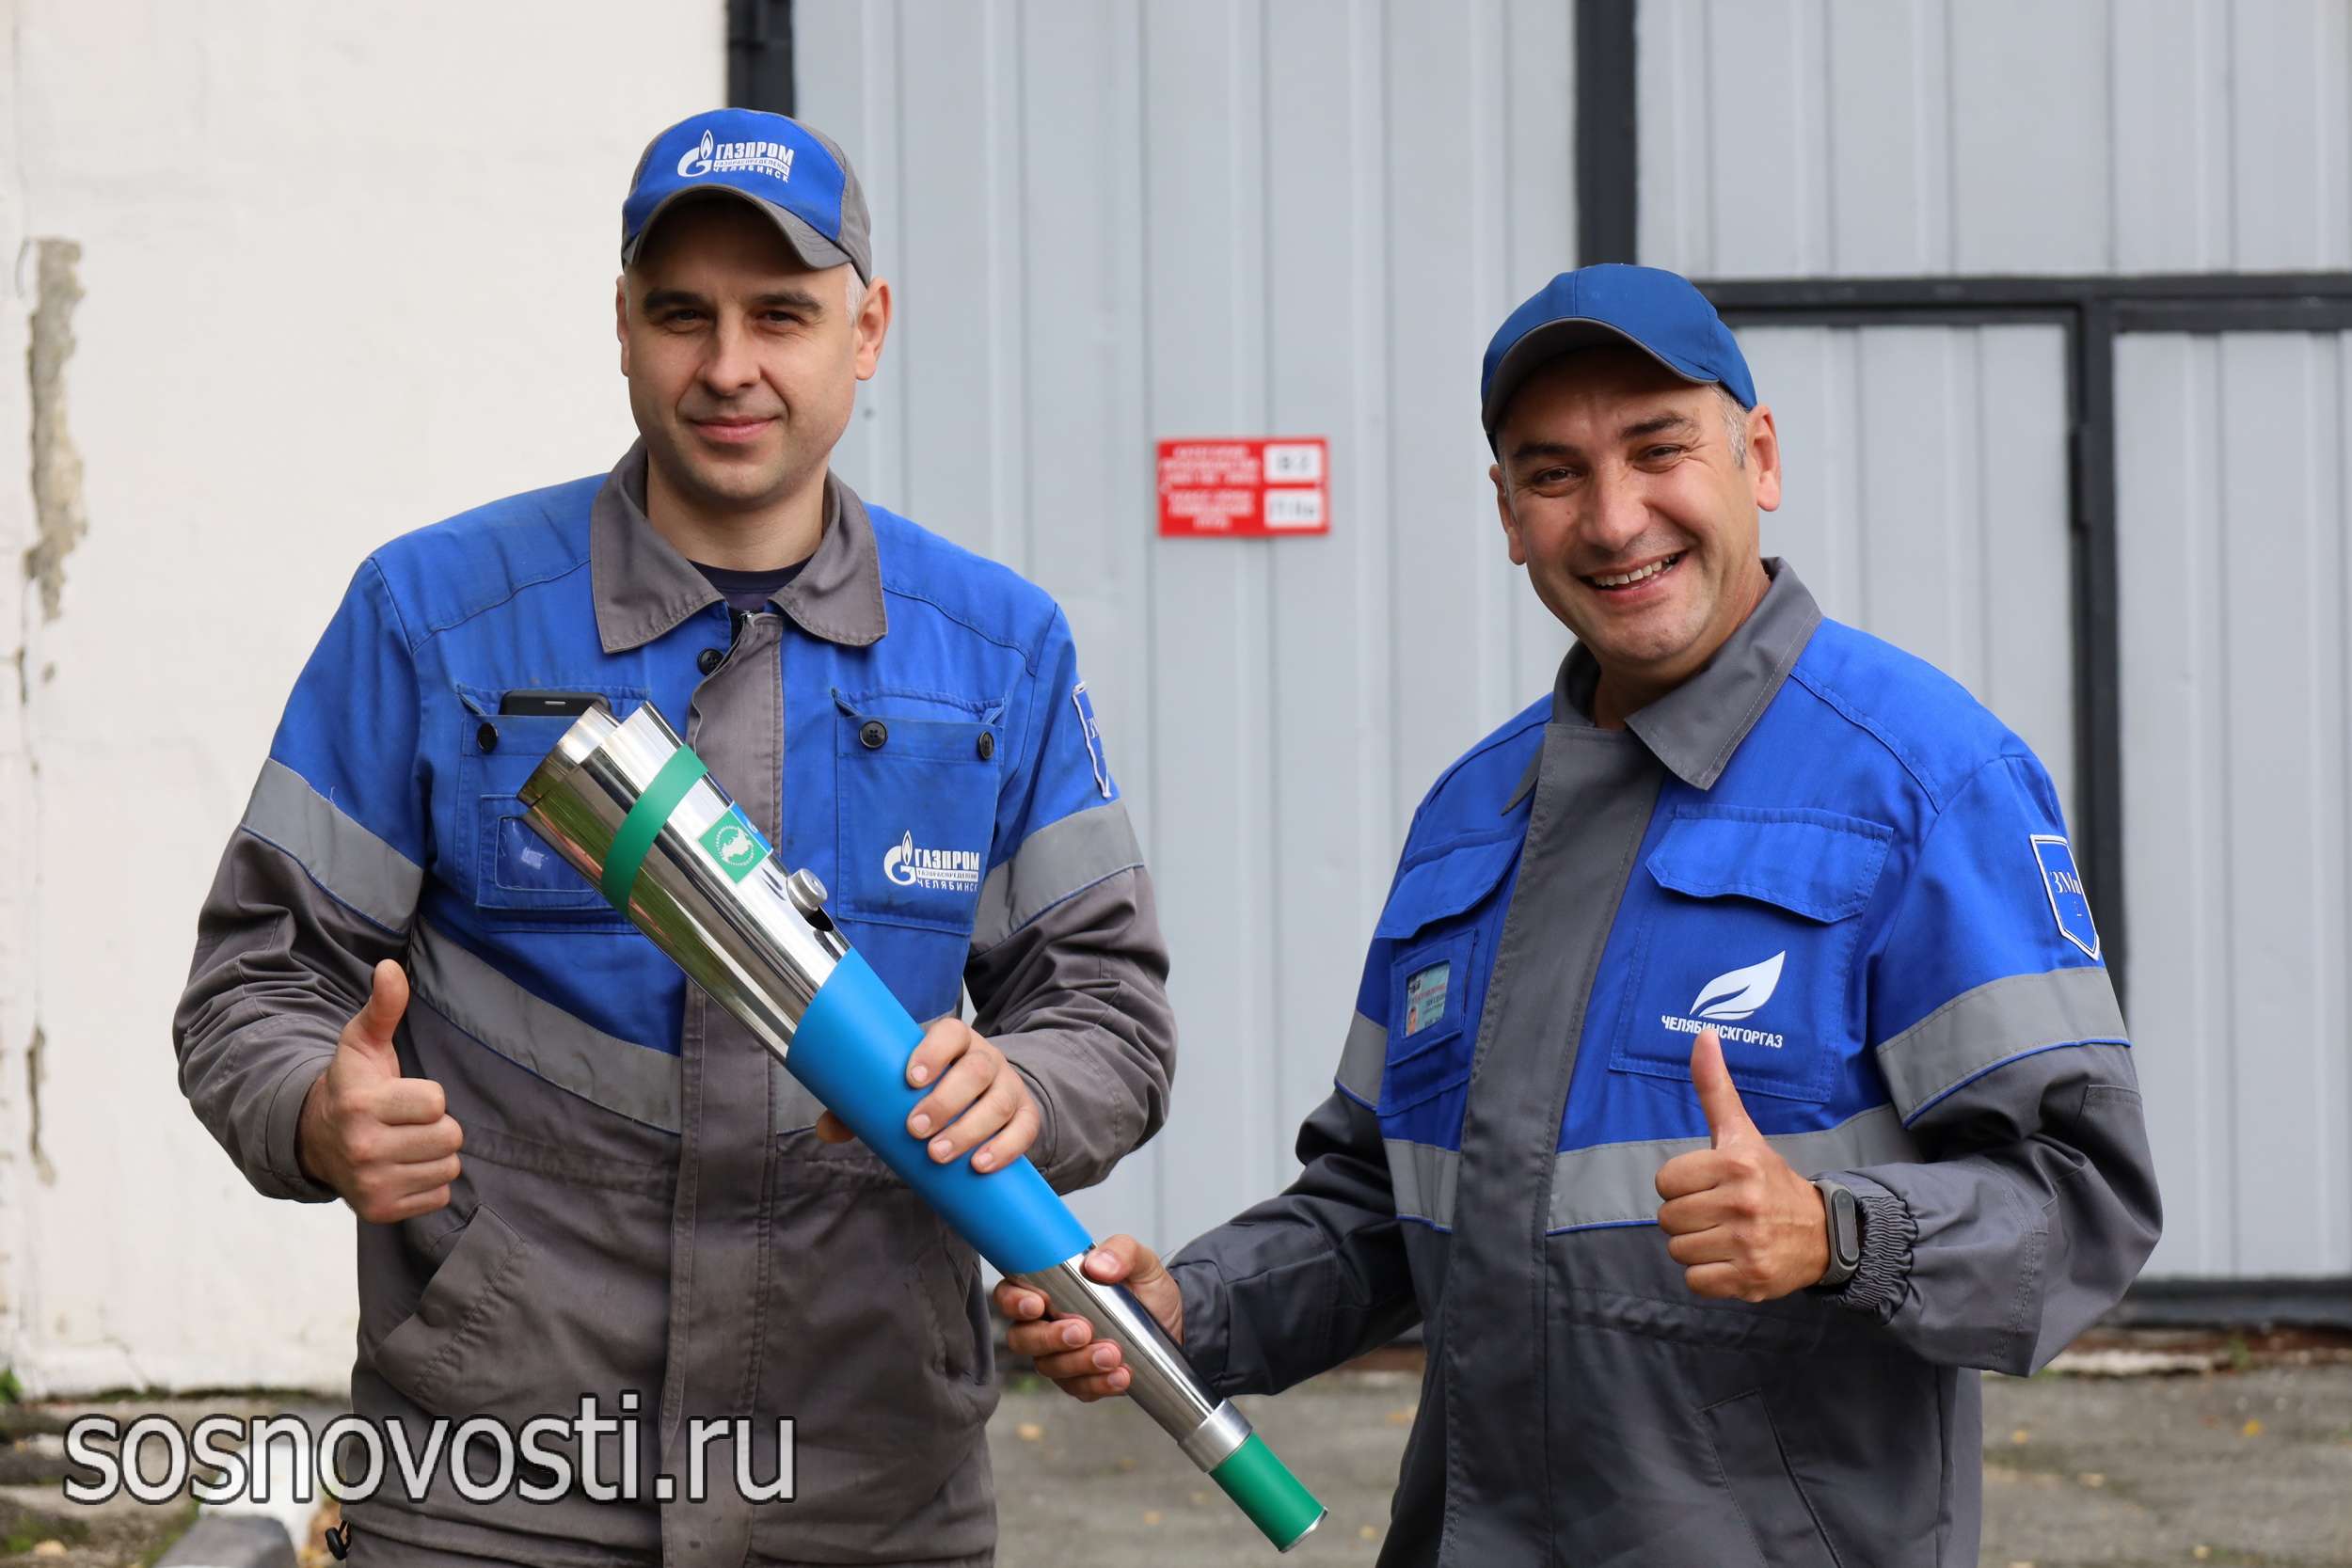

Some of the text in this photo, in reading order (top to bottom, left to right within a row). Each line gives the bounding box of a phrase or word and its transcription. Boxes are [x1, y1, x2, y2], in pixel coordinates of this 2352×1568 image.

[716, 141, 795, 166] ГАЗПРОМ
[713, 165, 789, 183] ЧЕЛЯБИНСК
[914, 848, 979, 870] ГАЗПРОМ
[917, 879, 978, 893] ЧЕЛЯБИНСК
